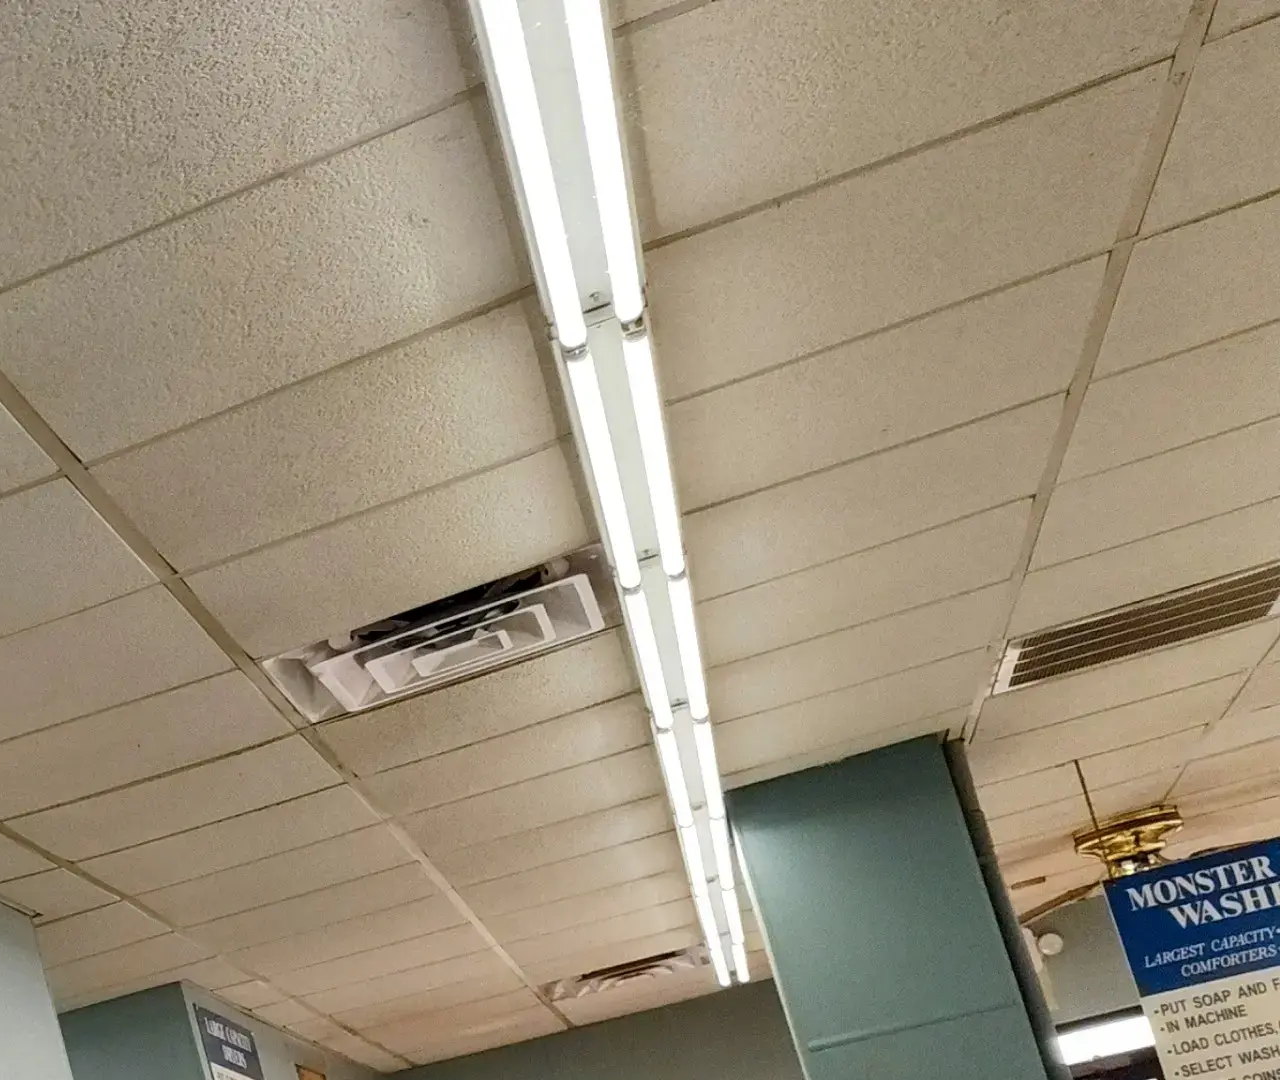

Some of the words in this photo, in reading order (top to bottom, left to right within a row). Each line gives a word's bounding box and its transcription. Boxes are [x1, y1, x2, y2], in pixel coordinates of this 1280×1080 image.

[1126, 855, 1277, 911] MONSTER
[1144, 943, 1205, 968] LARGEST
[1181, 944, 1277, 977] COMFORTERS
[1161, 999, 1187, 1016] PUT
[1193, 990, 1231, 1008] SOAP
[1238, 982, 1267, 999] AND
[1166, 1020, 1180, 1033] IN
[1185, 1004, 1248, 1029] MACHINE
[1173, 1037, 1209, 1055] LOAD
[1214, 1022, 1278, 1046] CLOTHES,
[1181, 1055, 1233, 1077] SELECT
